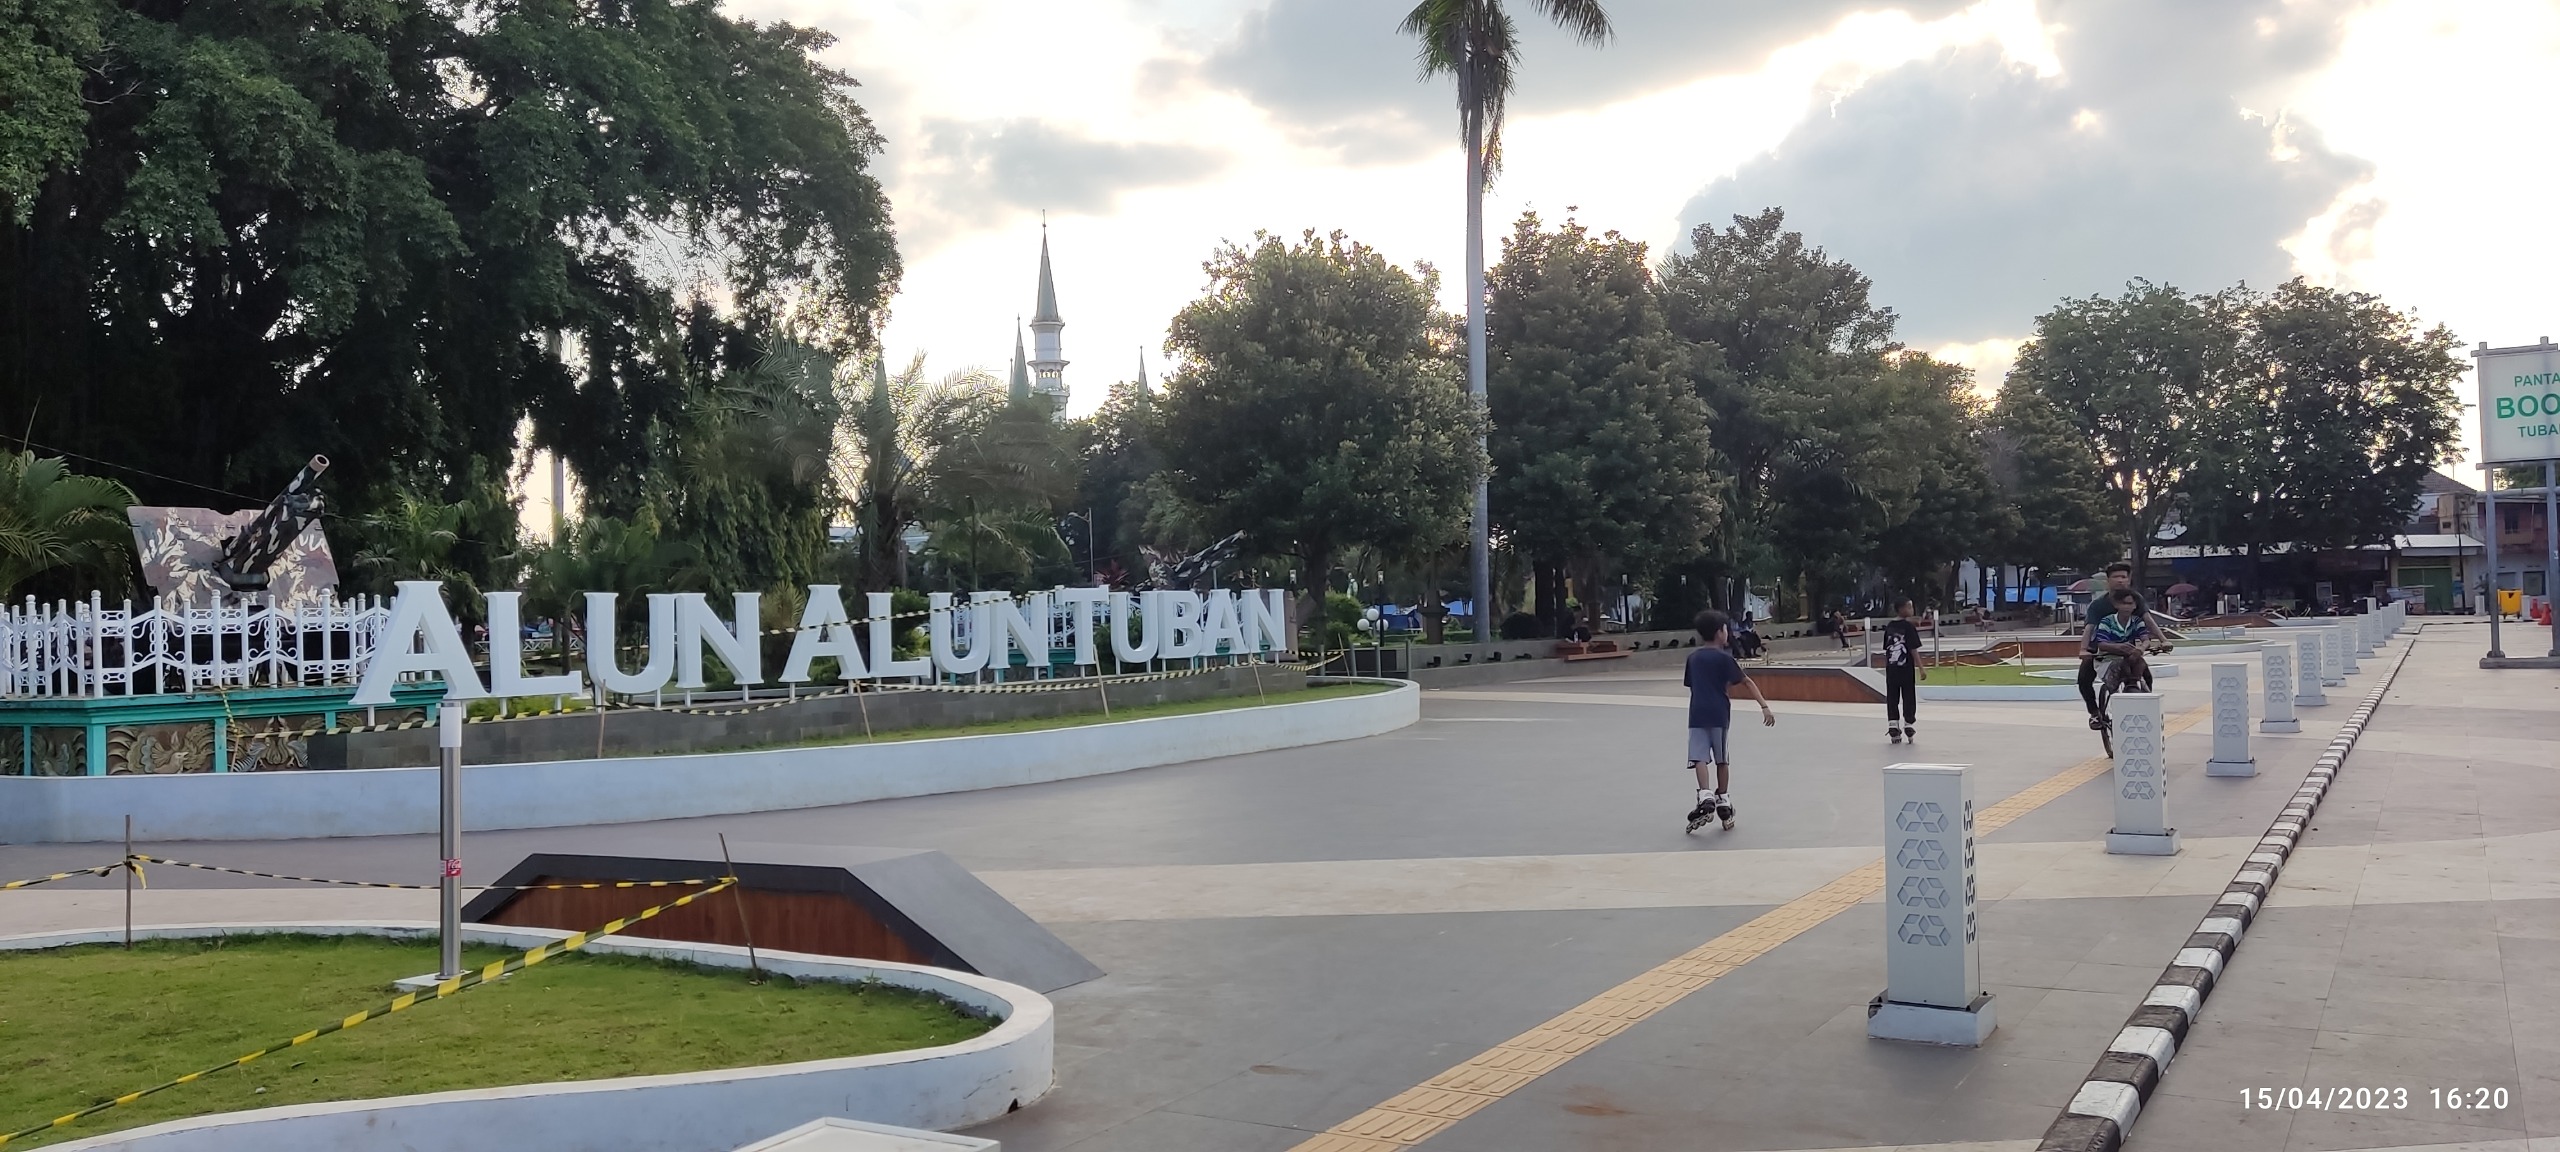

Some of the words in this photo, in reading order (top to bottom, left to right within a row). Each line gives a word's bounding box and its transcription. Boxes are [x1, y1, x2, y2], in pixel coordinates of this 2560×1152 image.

[2514, 372, 2560, 387] PANTA
[2496, 393, 2560, 419] BOO
[2517, 423, 2560, 438] TUBA
[349, 581, 763, 705] ALUN
[778, 584, 1050, 683] ALUN
[1053, 584, 1287, 665] TUBAN
